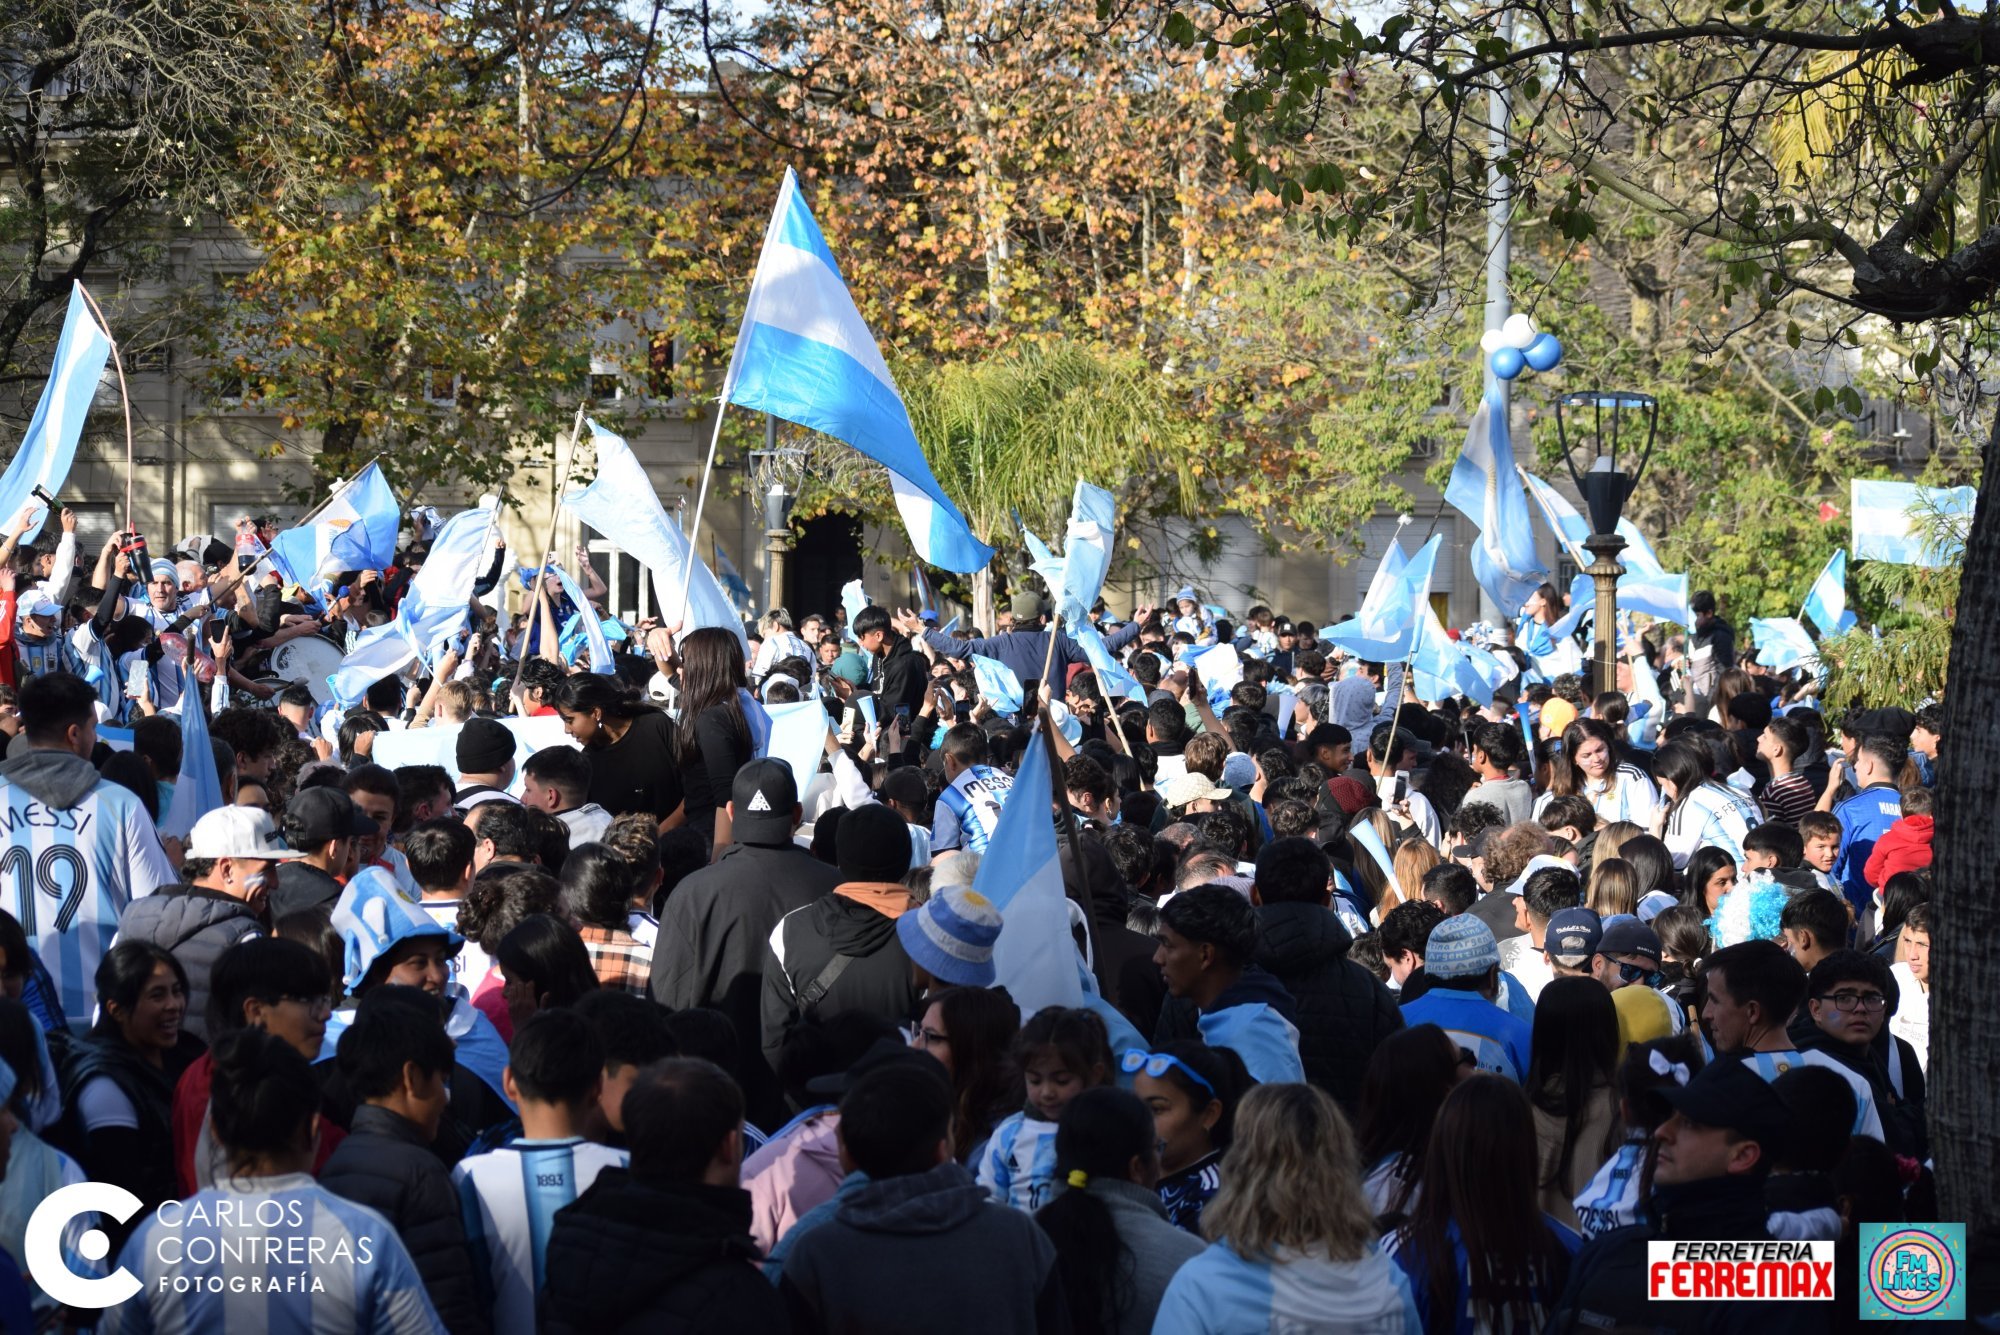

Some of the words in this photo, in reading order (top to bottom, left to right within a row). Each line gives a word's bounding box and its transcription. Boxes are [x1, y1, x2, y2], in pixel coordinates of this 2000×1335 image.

[963, 776, 1014, 798] MESS
[0, 844, 88, 936] 19
[536, 1174, 564, 1188] 1893
